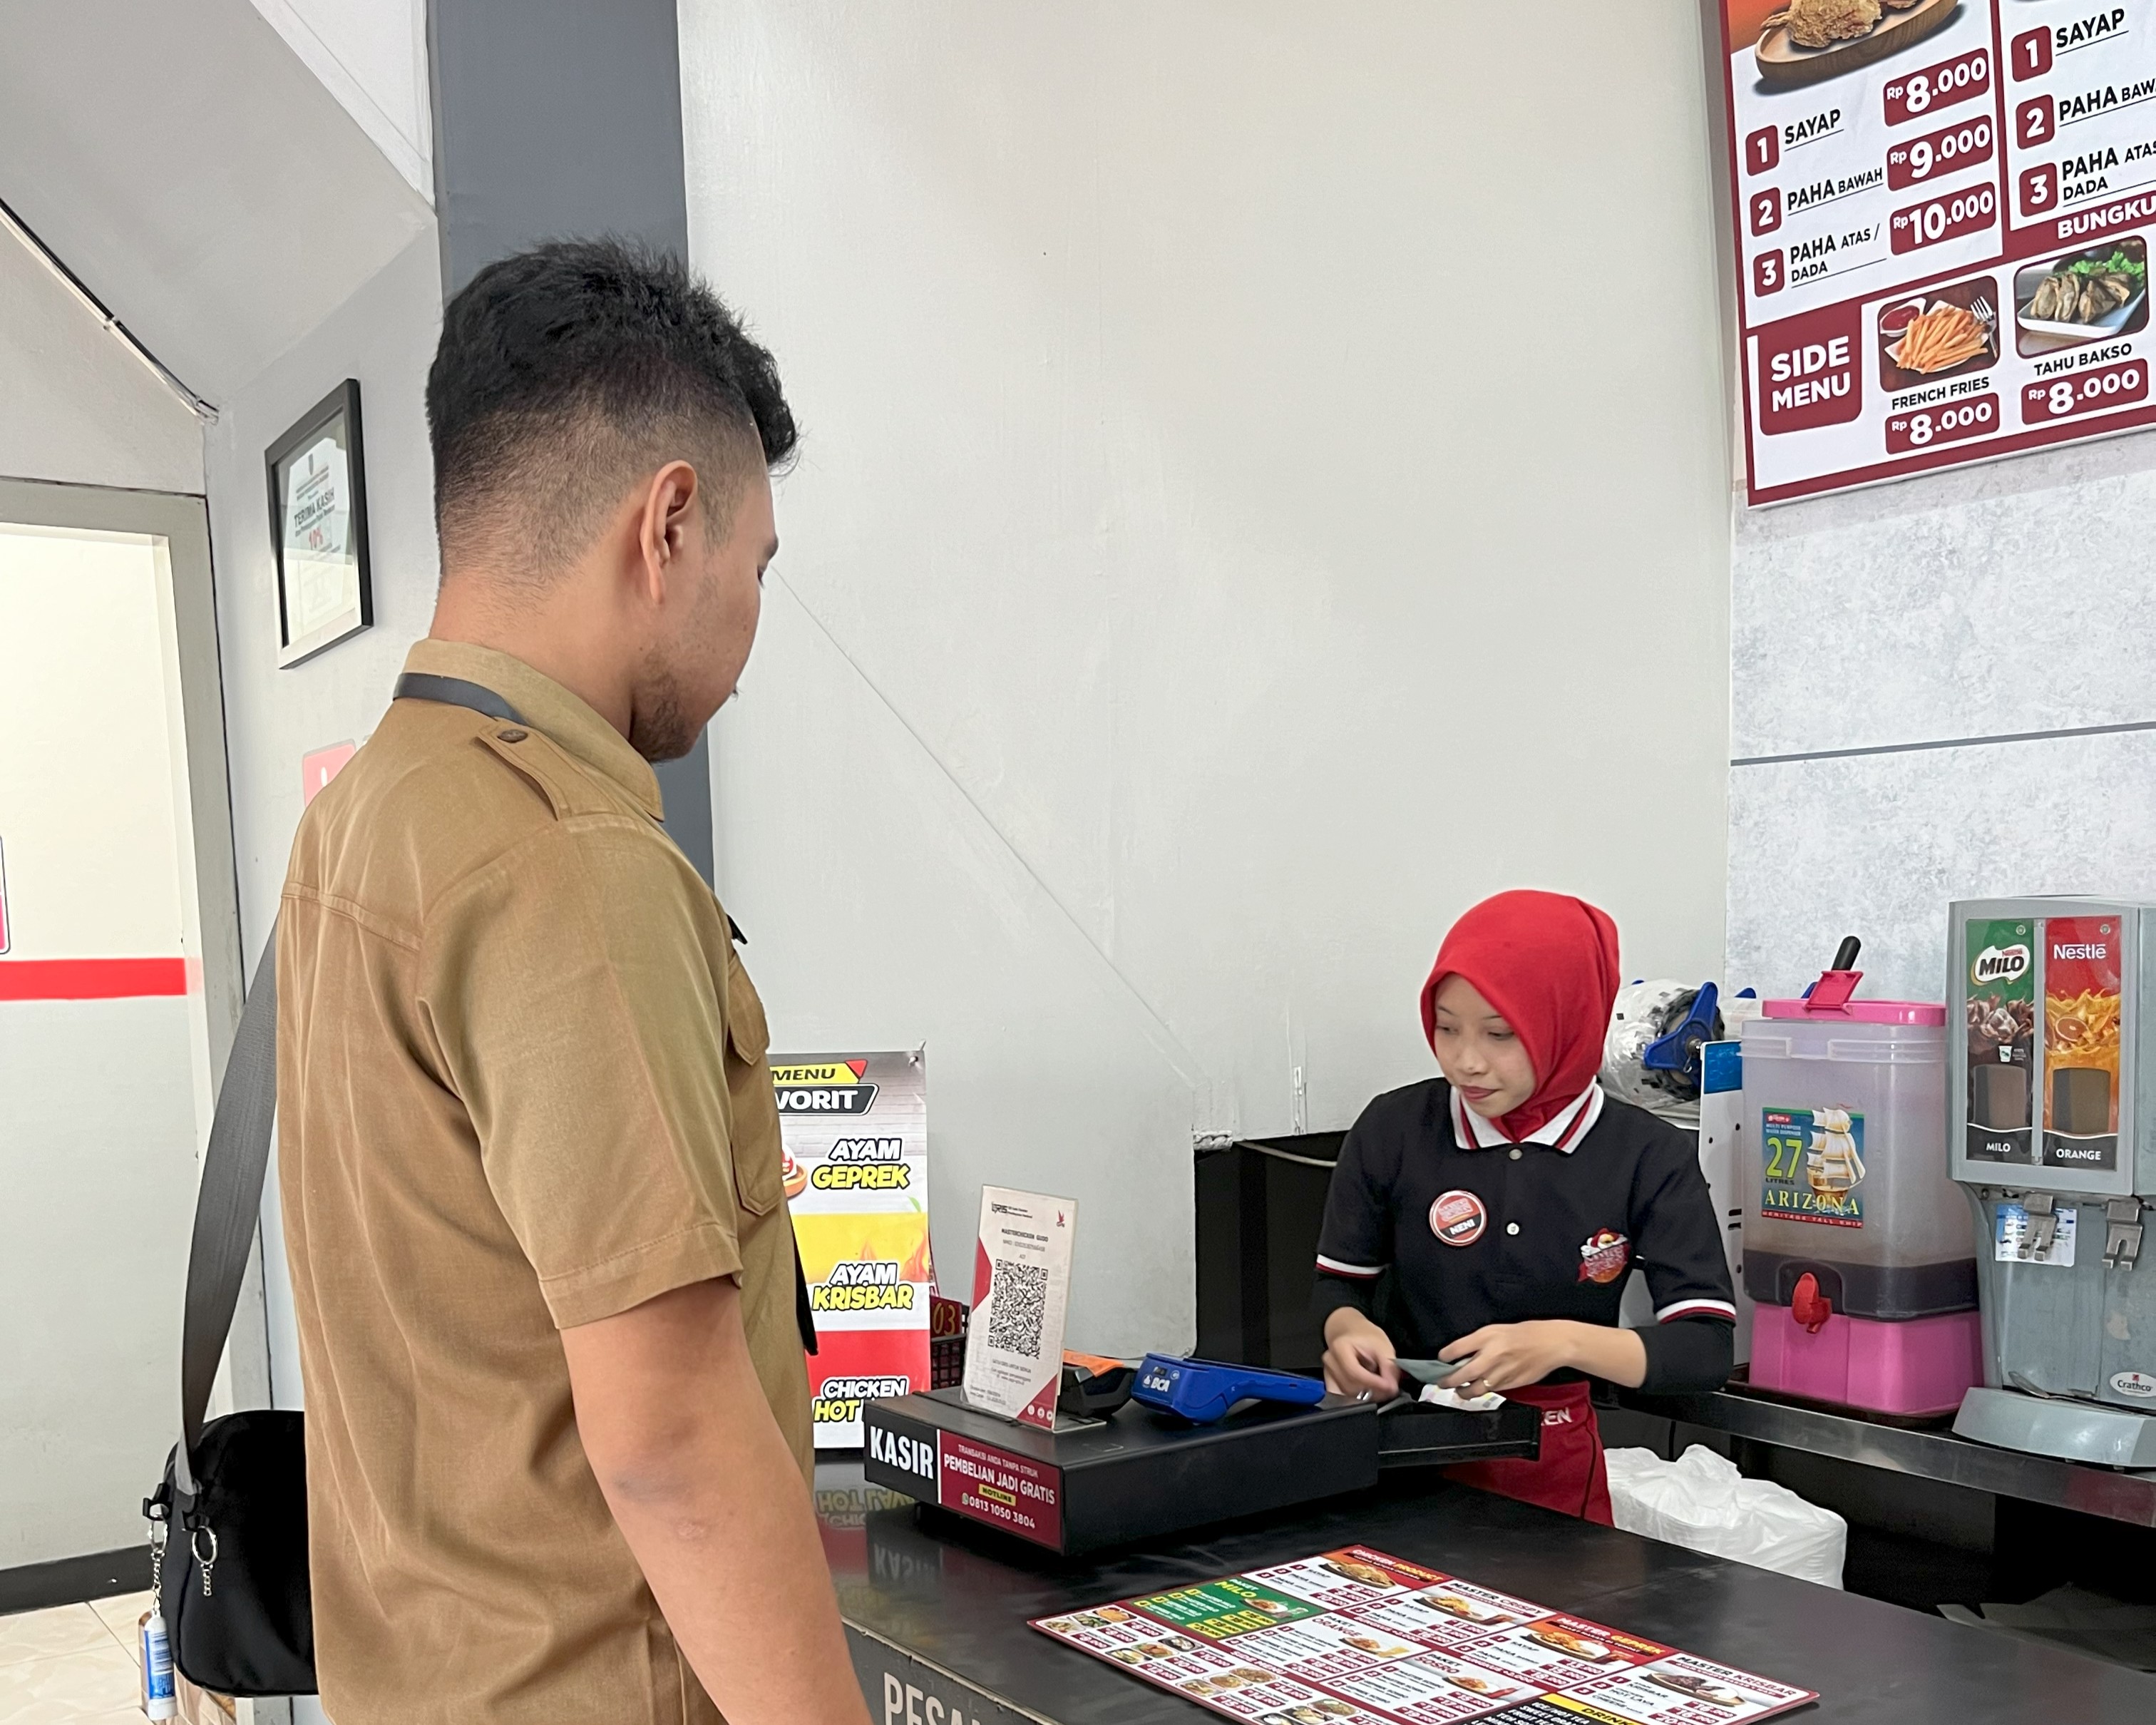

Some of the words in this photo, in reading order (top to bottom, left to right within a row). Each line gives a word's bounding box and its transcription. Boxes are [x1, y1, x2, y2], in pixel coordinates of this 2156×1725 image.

[2025, 39, 2038, 68] 1
[2056, 8, 2125, 48] SAYAP
[2026, 107, 2045, 138] 2
[2059, 86, 2118, 121] PAHA
[2121, 78, 2156, 102] BAW
[1757, 138, 1767, 163] 1
[1785, 109, 1841, 144] SAYAP
[2030, 174, 2048, 205] 3
[2062, 148, 2119, 180] PAHA
[2063, 177, 2108, 200] DADA
[1758, 199, 1775, 227] 2
[1787, 179, 1835, 212] PAHA
[1838, 168, 1884, 195] BAWAH
[1762, 260, 1777, 286] 3
[1790, 235, 1836, 265] PAHA
[1842, 228, 1872, 252] ATAS
[1791, 262, 1828, 283] DADA
[1771, 336, 1850, 383] SIDE
[2034, 355, 2075, 377] TAHU
[2080, 342, 2133, 367] BAKSO
[1772, 371, 1852, 413] MENU
[1891, 386, 1946, 411] FRENCH
[1950, 377, 1991, 399] FRIES
[1978, 956, 2025, 976] MILO
[772, 1068, 836, 1081] MENU
[829, 1138, 902, 1161] AYAM
[1766, 1137, 1803, 1179] 27
[1986, 1142, 2011, 1152] MILO
[2055, 1148, 2102, 1161] ORANGE
[812, 1163, 910, 1189] GEPREK
[1765, 1189, 1859, 1216] ARIZONA
[830, 1263, 898, 1286] AYAM
[812, 1284, 914, 1311] KRISBAR
[823, 1378, 908, 1399] CHICKEN
[813, 1398, 862, 1422] HOT
[1541, 1407, 1573, 1426] EN
[870, 1425, 934, 1480] KASIR
[944, 1453, 995, 1484] PEMBELIAN
[996, 1472, 1018, 1493] JADI
[1020, 1480, 1055, 1505] GRATIS
[969, 1496, 990, 1512] 0813
[991, 1503, 1012, 1520] 1050
[1012, 1511, 1036, 1529] 3804
[1215, 1582, 1256, 1598] MILO
[1450, 1582, 1498, 1599] MASTER
[1499, 1599, 1542, 1614] CRISPY
[1557, 1617, 1611, 1637] MASTER
[1610, 1634, 1664, 1654] GEPREK
[1678, 1657, 1732, 1675] MASTER
[1733, 1674, 1795, 1695] KRISBAR
[884, 1672, 981, 1725] PES
